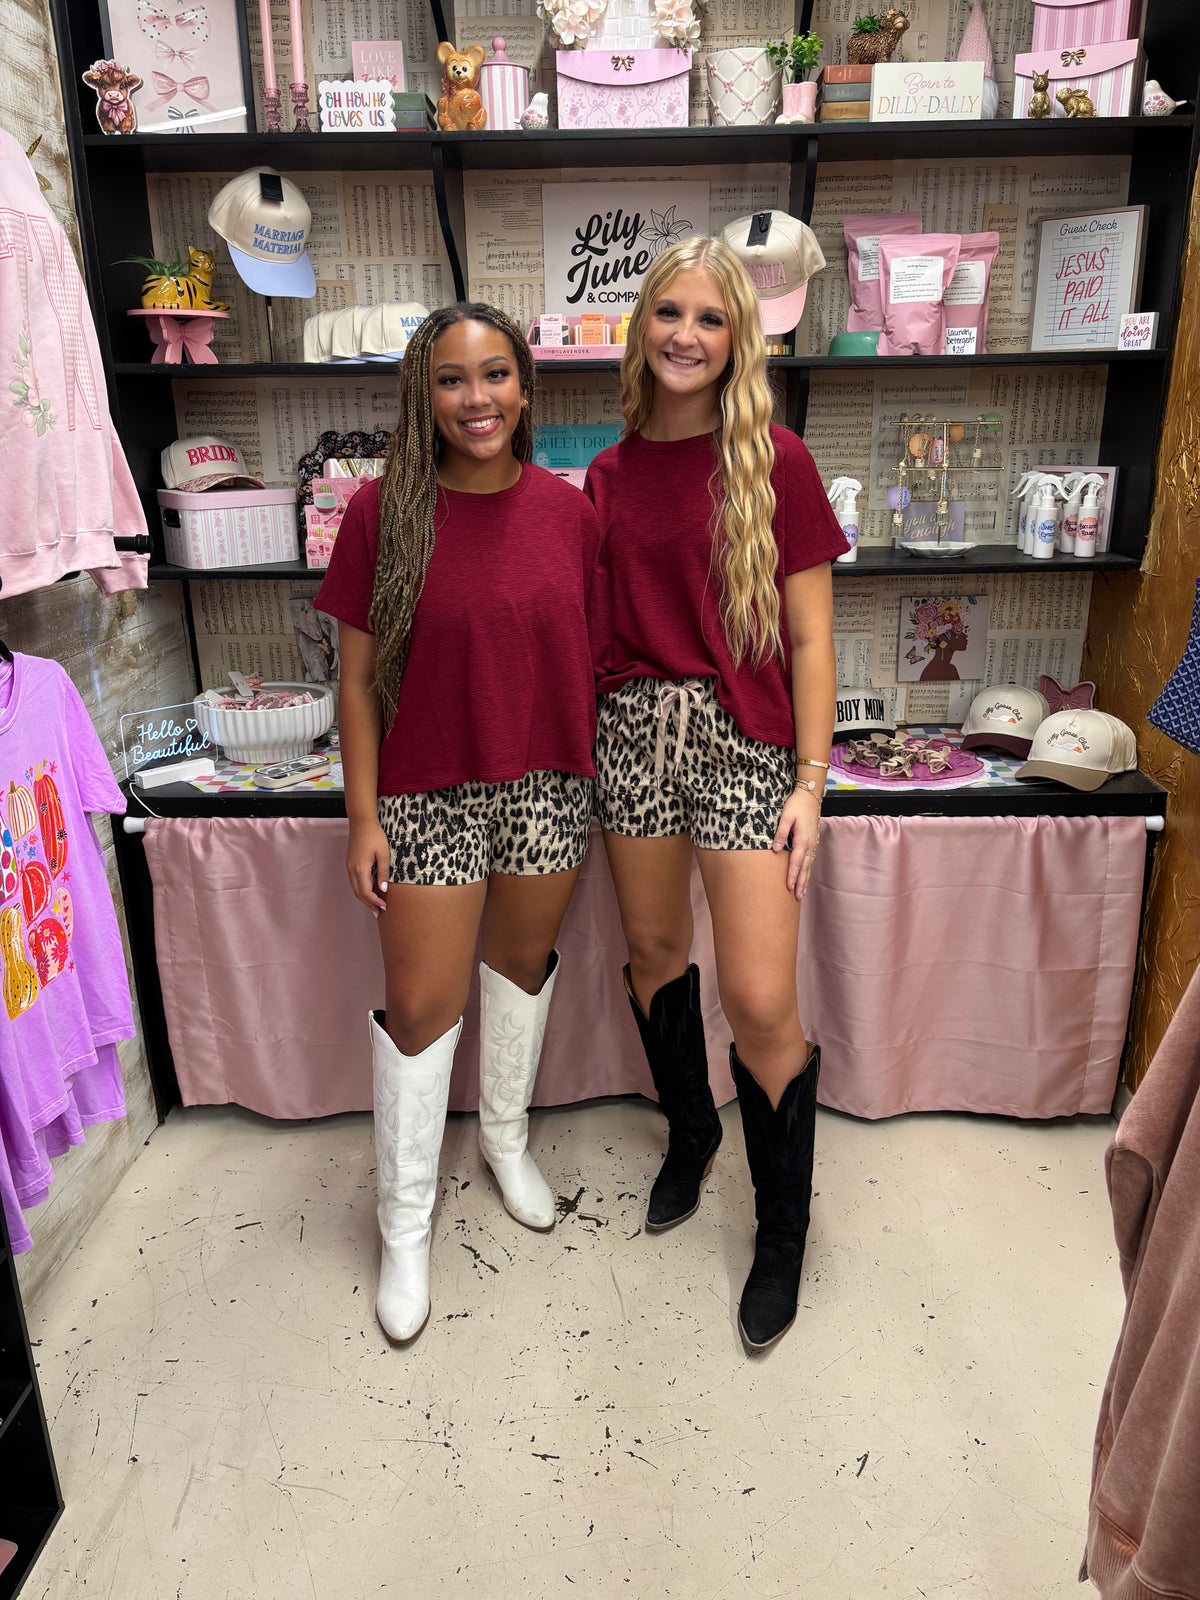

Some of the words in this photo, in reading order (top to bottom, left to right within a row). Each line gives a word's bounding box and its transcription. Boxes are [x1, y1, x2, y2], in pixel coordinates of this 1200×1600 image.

[360, 51, 396, 64] LOVE
[364, 65, 394, 78] LIKE
[904, 72, 941, 94] Born
[944, 77, 956, 89] to
[325, 91, 342, 108] OH
[346, 91, 370, 108] HOW
[877, 95, 980, 114] DILLY-DALLY
[369, 110, 385, 127] US
[571, 208, 646, 256] Lily
[1060, 223, 1088, 236] Guest
[1089, 219, 1118, 233] Check
[1055, 247, 1110, 280] JESUS
[566, 250, 650, 304] June
[744, 262, 788, 290] AMA
[586, 292, 596, 304] &
[598, 291, 640, 303] COMPA
[1063, 275, 1103, 305] PAID
[1058, 307, 1077, 331] IT
[1081, 299, 1110, 326] ALL
[1125, 316, 1138, 326] YOU
[1139, 315, 1151, 325] ARE
[946, 336, 975, 346] Detergent
[947, 329, 972, 337] Laundry
[1120, 325, 1151, 341] doing
[952, 345, 965, 354] $25
[1123, 339, 1142, 348] GREAT
[535, 436, 578, 449] SHEET
[186, 444, 239, 467] BRIDE
[904, 516, 927, 534] you
[911, 520, 958, 540] enough
[836, 699, 861, 722] BOY
[863, 698, 885, 721] MOM
[994, 702, 1012, 711] Goose
[136, 719, 184, 744] Hello
[1060, 728, 1079, 739] Goose
[130, 731, 211, 765] Beautiful
